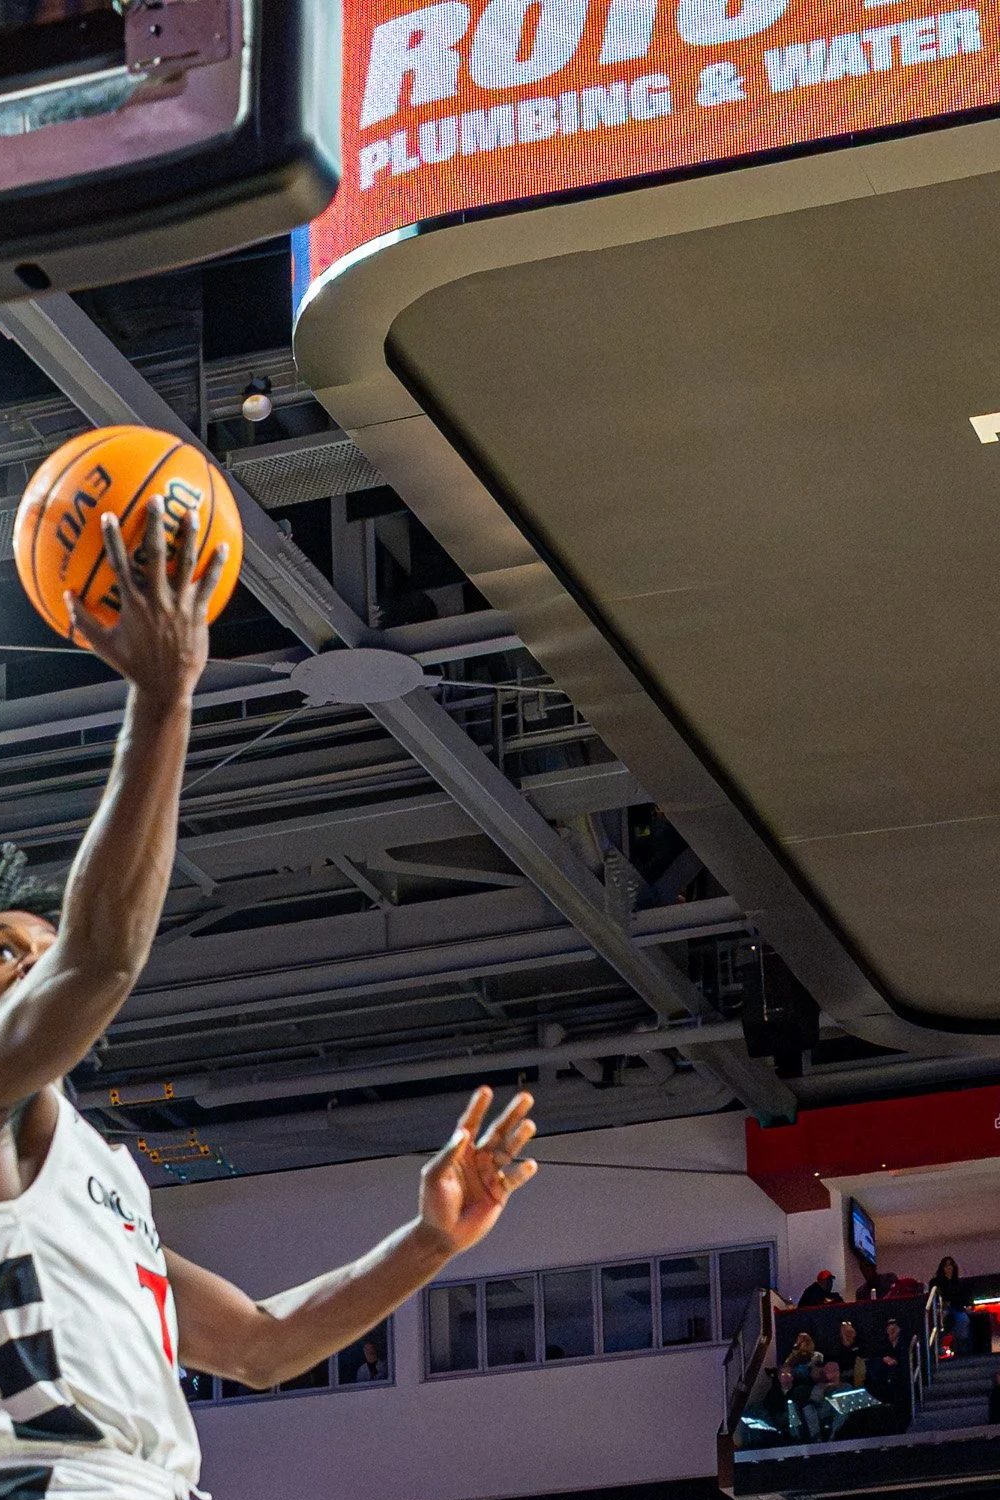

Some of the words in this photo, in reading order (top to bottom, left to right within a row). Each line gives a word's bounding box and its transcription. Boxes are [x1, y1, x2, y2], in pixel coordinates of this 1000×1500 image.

[358, 73, 672, 191] PLUMBING
[698, 61, 747, 107] &
[763, 8, 984, 92] WATER
